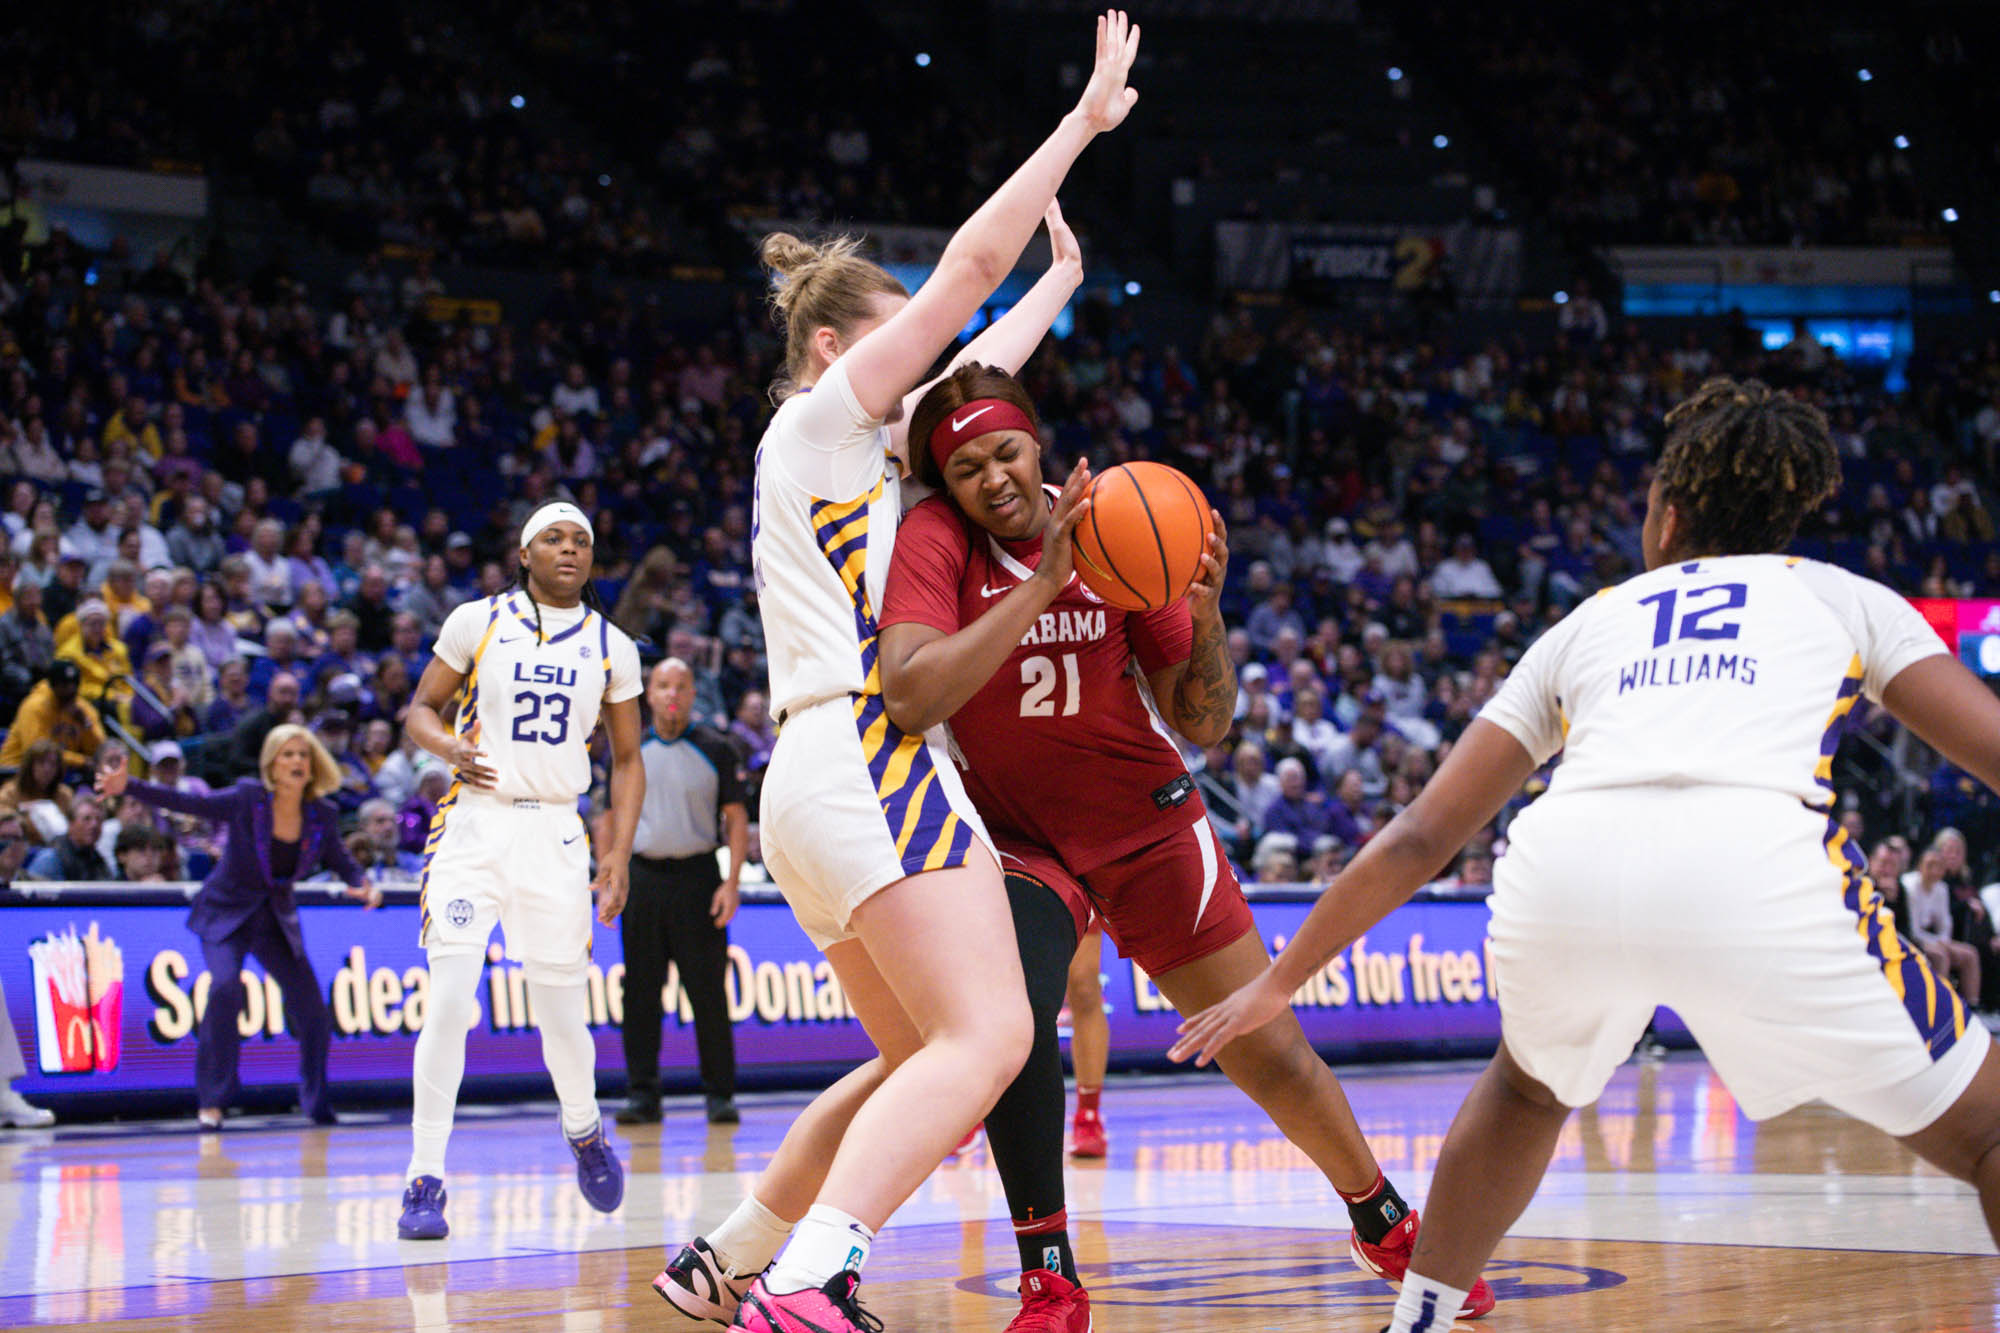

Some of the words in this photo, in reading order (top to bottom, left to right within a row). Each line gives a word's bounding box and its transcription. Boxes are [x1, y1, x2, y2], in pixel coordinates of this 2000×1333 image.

[1017, 610, 1106, 646] ABAMA
[1637, 582, 1748, 650] 12
[514, 662, 577, 687] LSU
[1019, 652, 1081, 717] 21
[1619, 653, 1758, 696] WILLIAMS
[511, 691, 571, 746] 23
[1351, 936, 1406, 1005] for
[1408, 933, 1484, 1003] free
